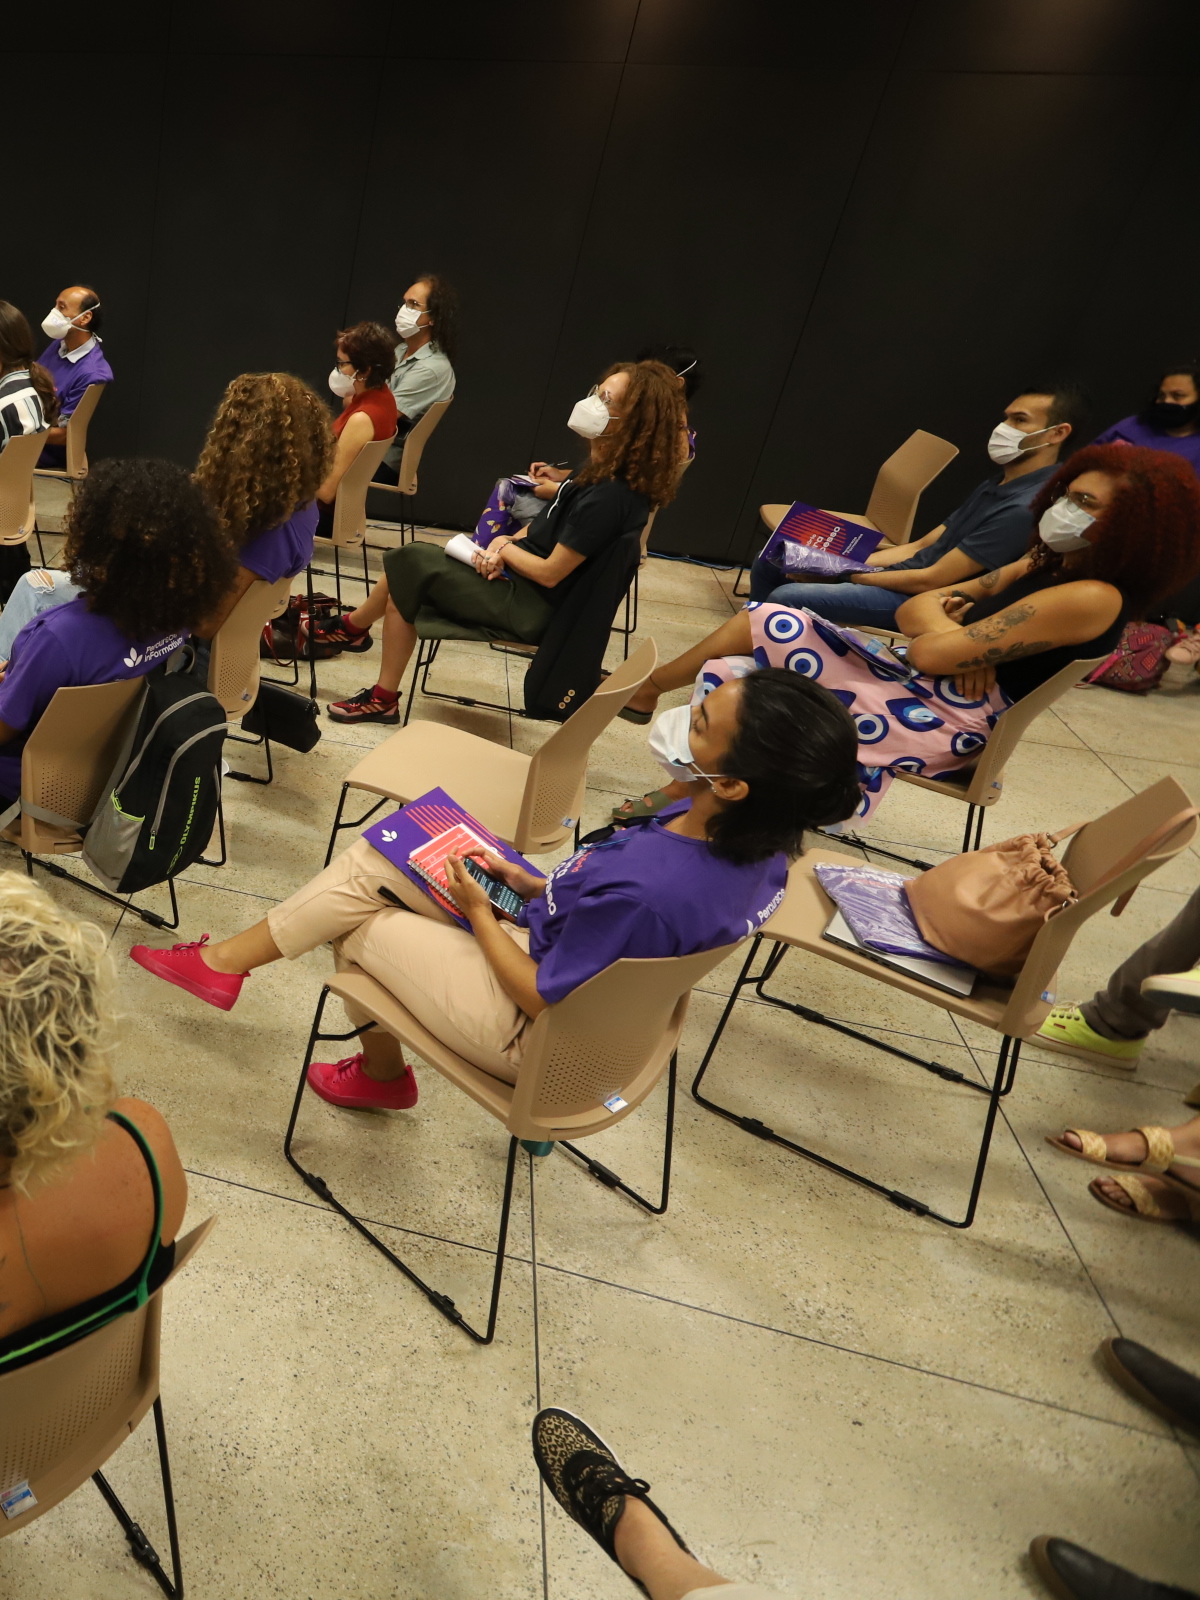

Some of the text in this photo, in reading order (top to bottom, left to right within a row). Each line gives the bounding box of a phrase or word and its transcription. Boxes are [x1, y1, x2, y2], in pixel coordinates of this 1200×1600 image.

[820, 526, 841, 552] cesso
[179, 776, 201, 846] OLYMPIKUS
[756, 888, 786, 924] Percursos
